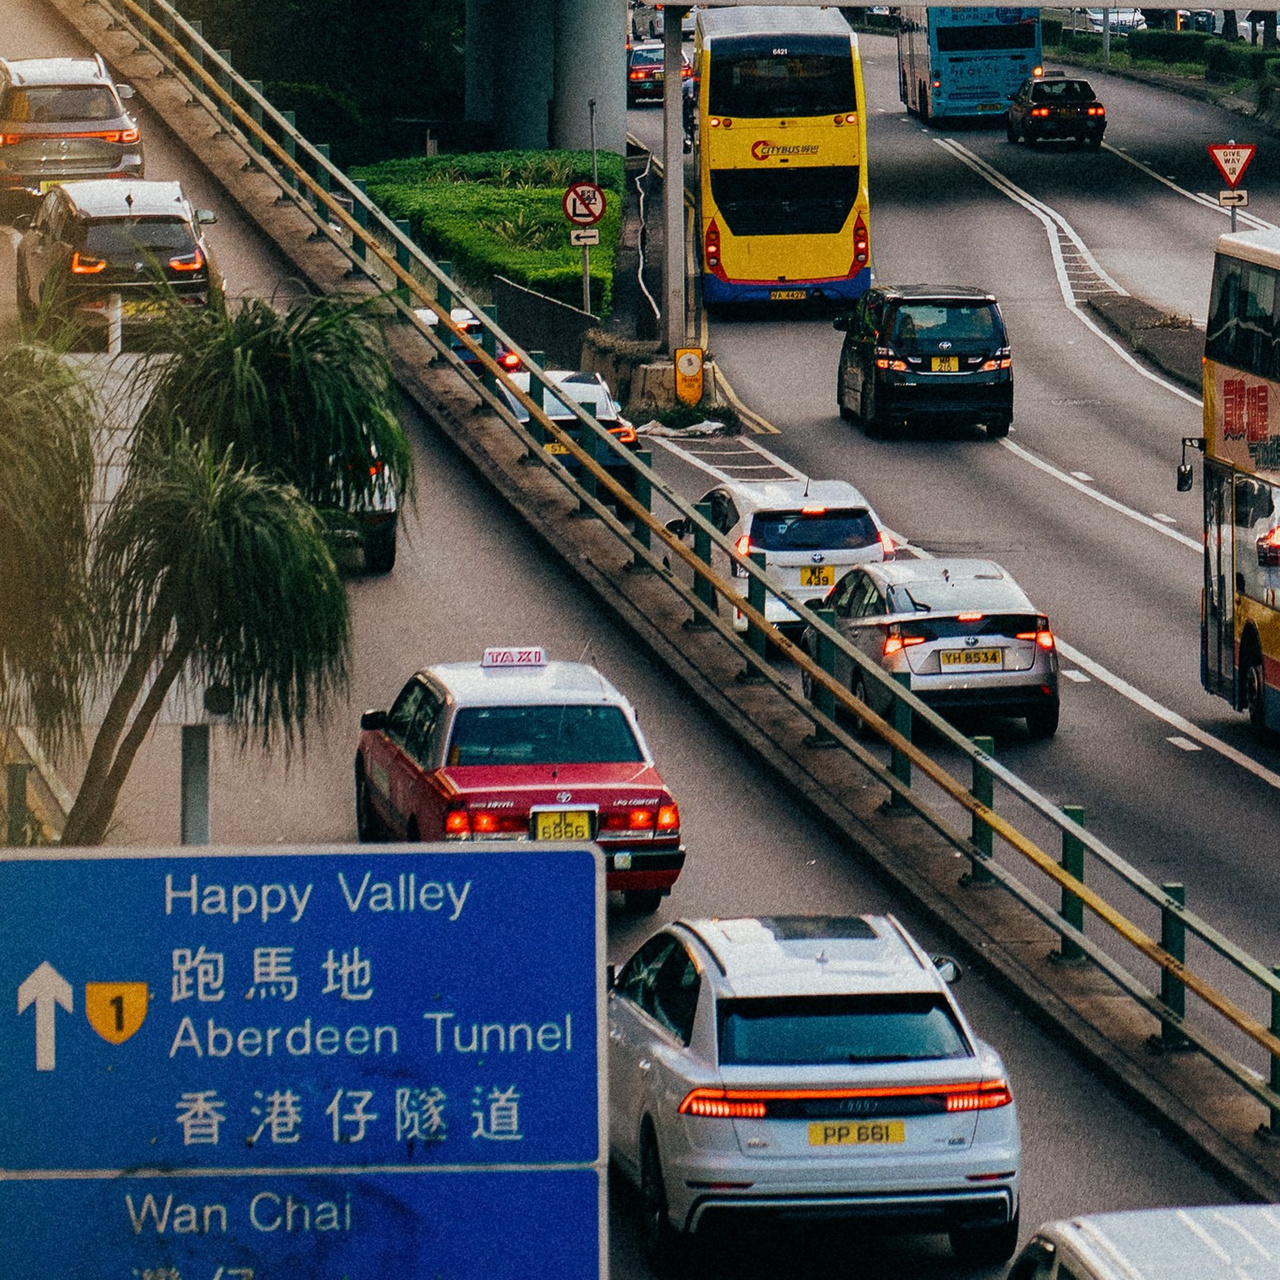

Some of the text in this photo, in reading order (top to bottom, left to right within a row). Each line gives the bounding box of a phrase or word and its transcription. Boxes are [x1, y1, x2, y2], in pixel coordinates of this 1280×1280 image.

[761, 144, 800, 154] CITYBUS
[806, 576, 829, 586] 439
[810, 567, 824, 576] WF
[488, 651, 541, 663] TAXI
[945, 650, 997, 665] YH 8534
[164, 871, 472, 924] Happy Valley
[170, 946, 374, 1003] 跑馬地
[109, 994, 125, 1033] 1
[169, 1012, 573, 1058] Aberdeen Tunnel
[175, 1084, 523, 1146] 香港仔隧道
[823, 1125, 890, 1144] PP 661
[125, 1190, 352, 1235] Wan Chai
